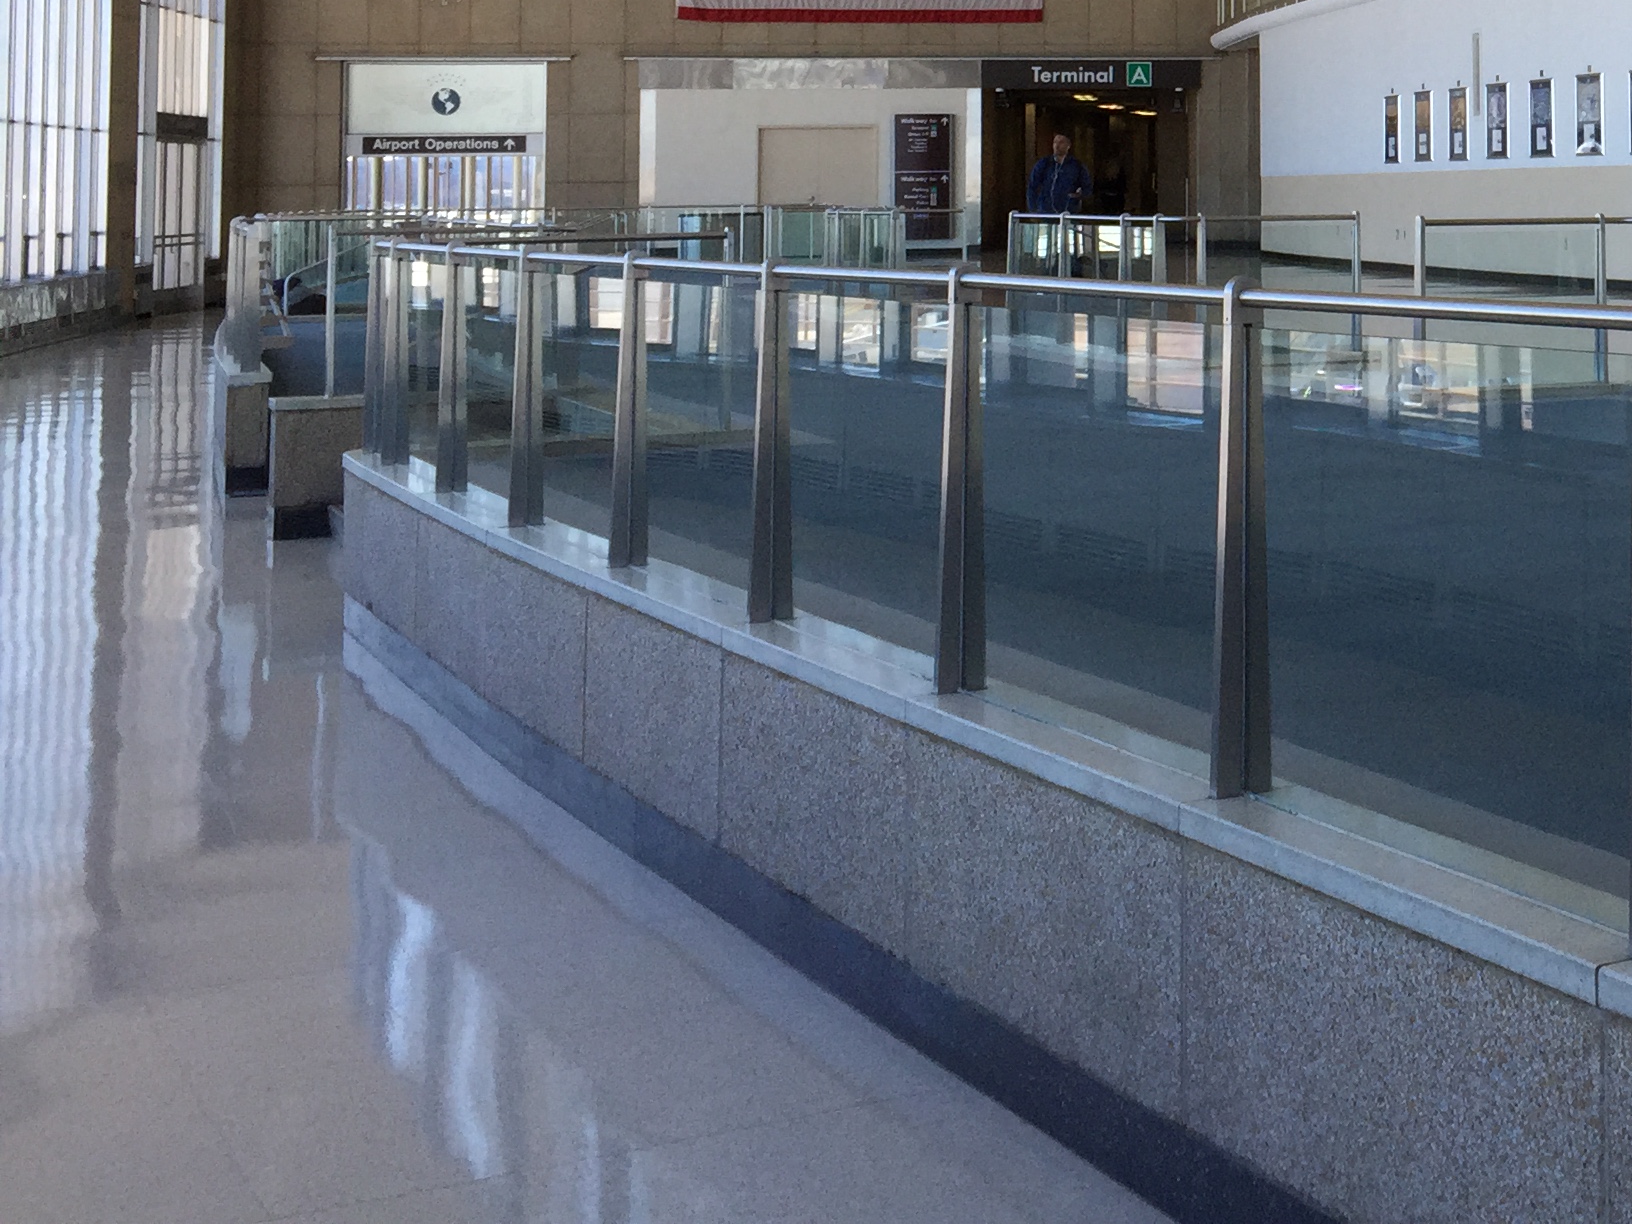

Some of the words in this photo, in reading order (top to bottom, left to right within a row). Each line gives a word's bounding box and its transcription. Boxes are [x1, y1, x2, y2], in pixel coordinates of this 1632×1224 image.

[1031, 66, 1114, 83] Terminal
[1131, 66, 1148, 84] A
[373, 138, 419, 151] Airport
[425, 138, 499, 150] Operations
